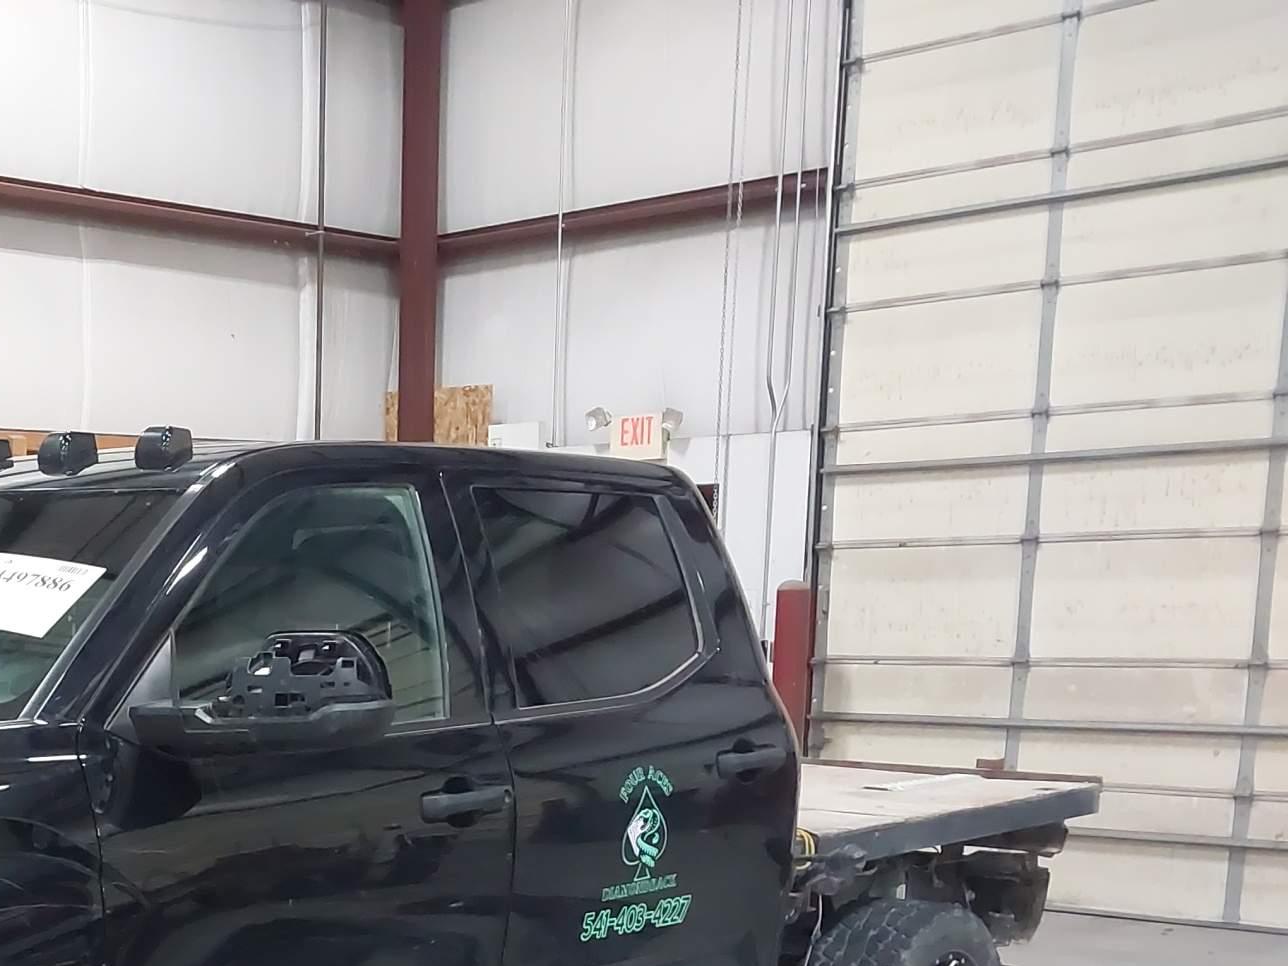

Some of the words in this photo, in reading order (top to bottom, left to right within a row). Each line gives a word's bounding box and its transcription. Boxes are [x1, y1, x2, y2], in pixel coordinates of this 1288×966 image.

[620, 416, 653, 446] EXIT
[619, 767, 645, 803] FOUR
[648, 765, 673, 796] ACES
[581, 895, 692, 941] 541-403-4227
